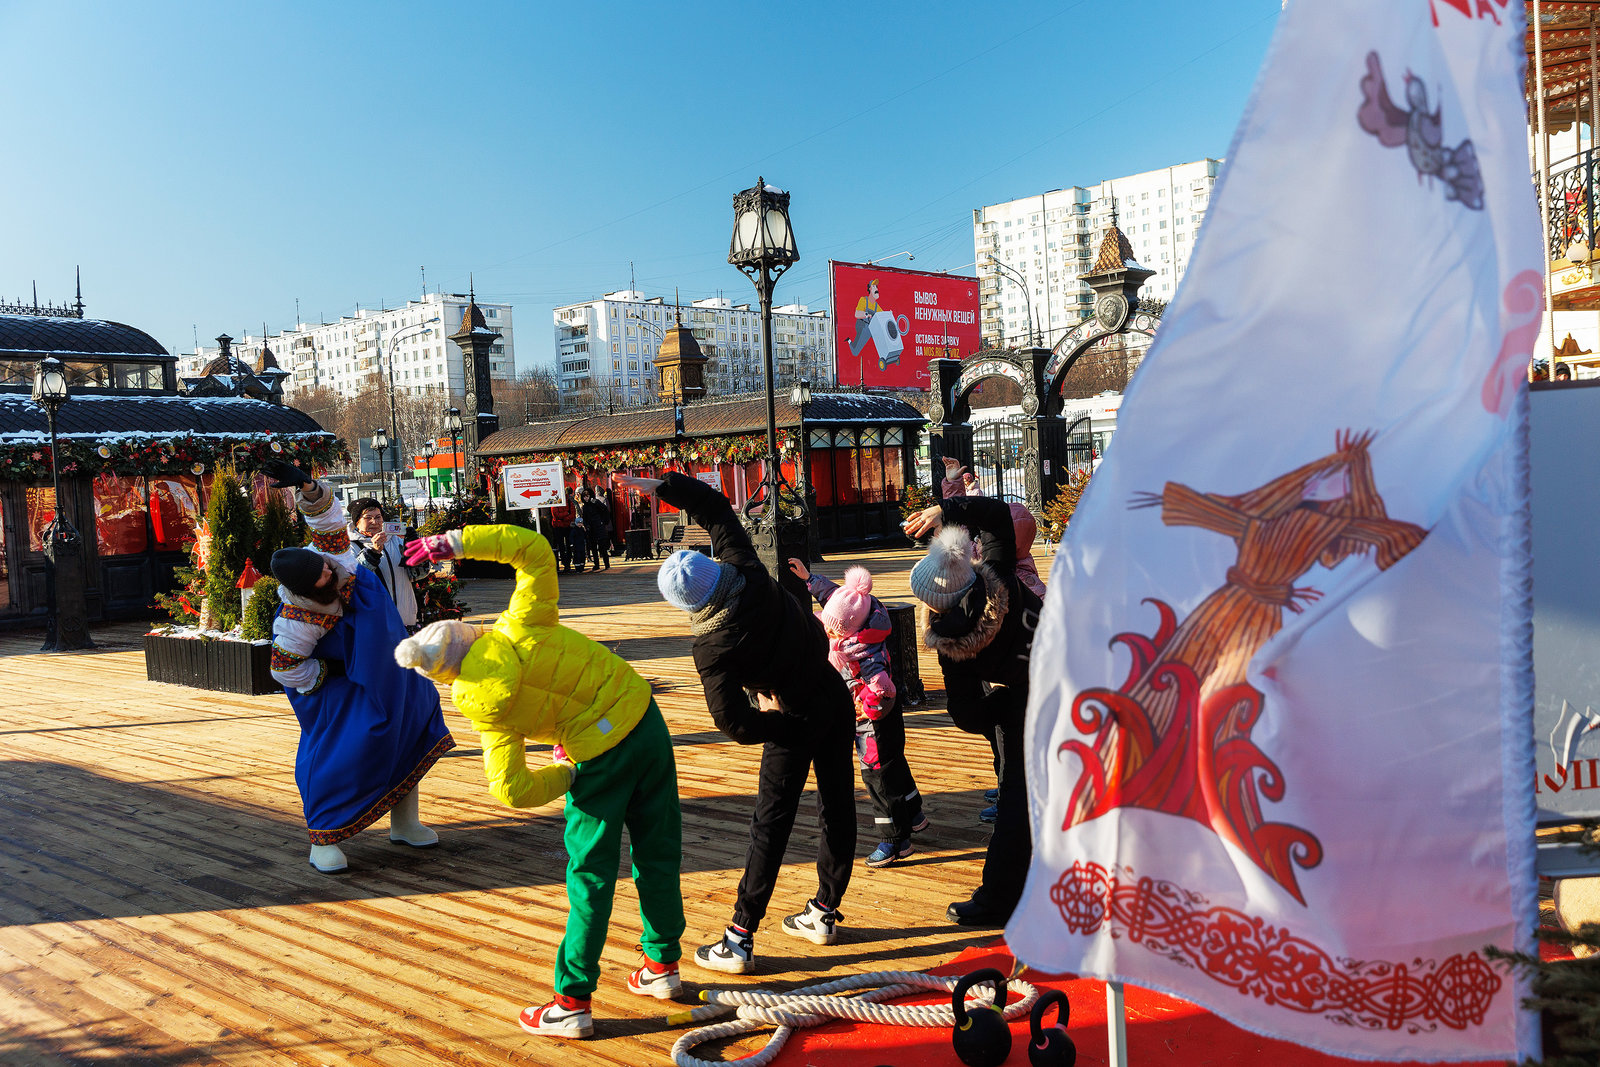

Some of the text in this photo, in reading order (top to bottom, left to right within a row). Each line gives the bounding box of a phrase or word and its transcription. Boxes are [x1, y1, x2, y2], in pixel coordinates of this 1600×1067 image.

[914, 291, 937, 305] ВЫВОЗ
[914, 307, 975, 324] НЕНУЖНЫХ ВЕЩЕЙ
[915, 334, 960, 346] ОСТАВЬТЕ ЗЯВКУ
[915, 346, 923, 356] НА
